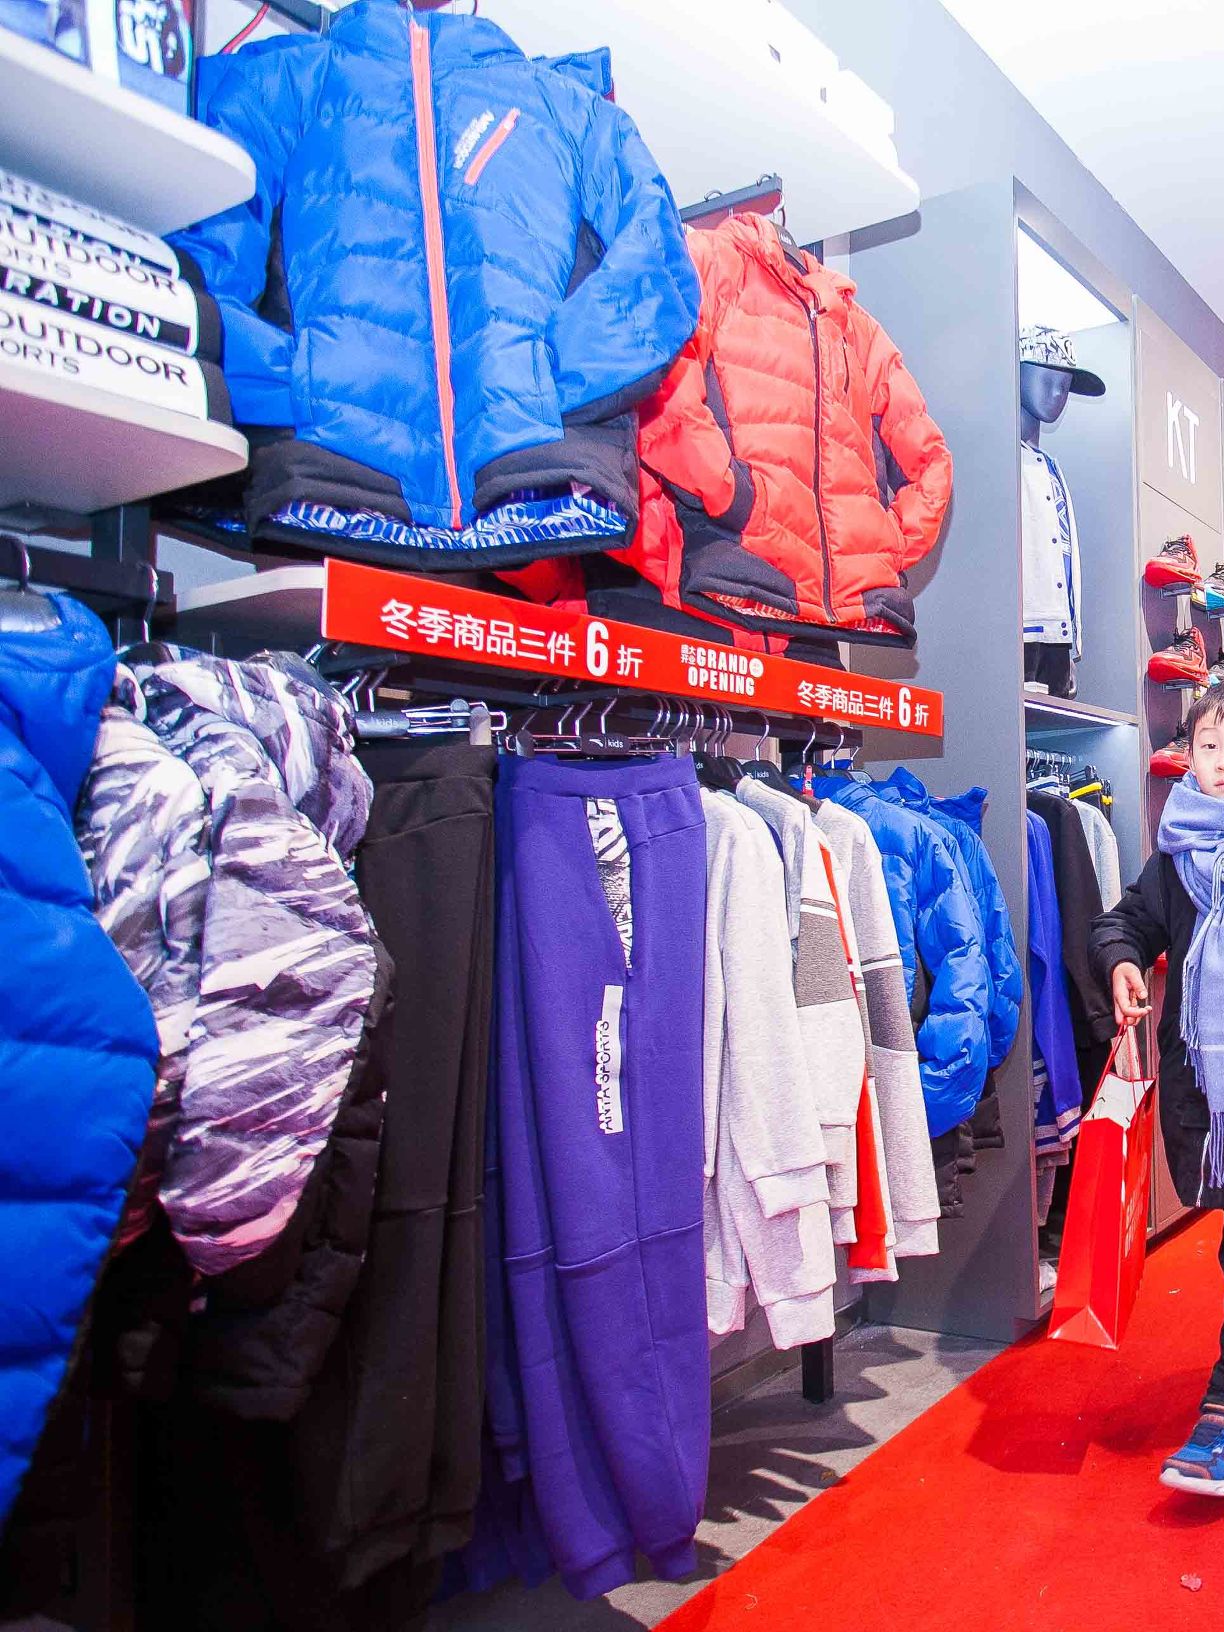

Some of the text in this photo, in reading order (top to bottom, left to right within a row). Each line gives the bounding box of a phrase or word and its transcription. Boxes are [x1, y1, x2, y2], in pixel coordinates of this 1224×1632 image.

[0, 216, 177, 296] UTDOOR
[1166, 391, 1200, 484] KT
[688, 665, 755, 697] OPENING
[696, 646, 748, 675] GRAND
